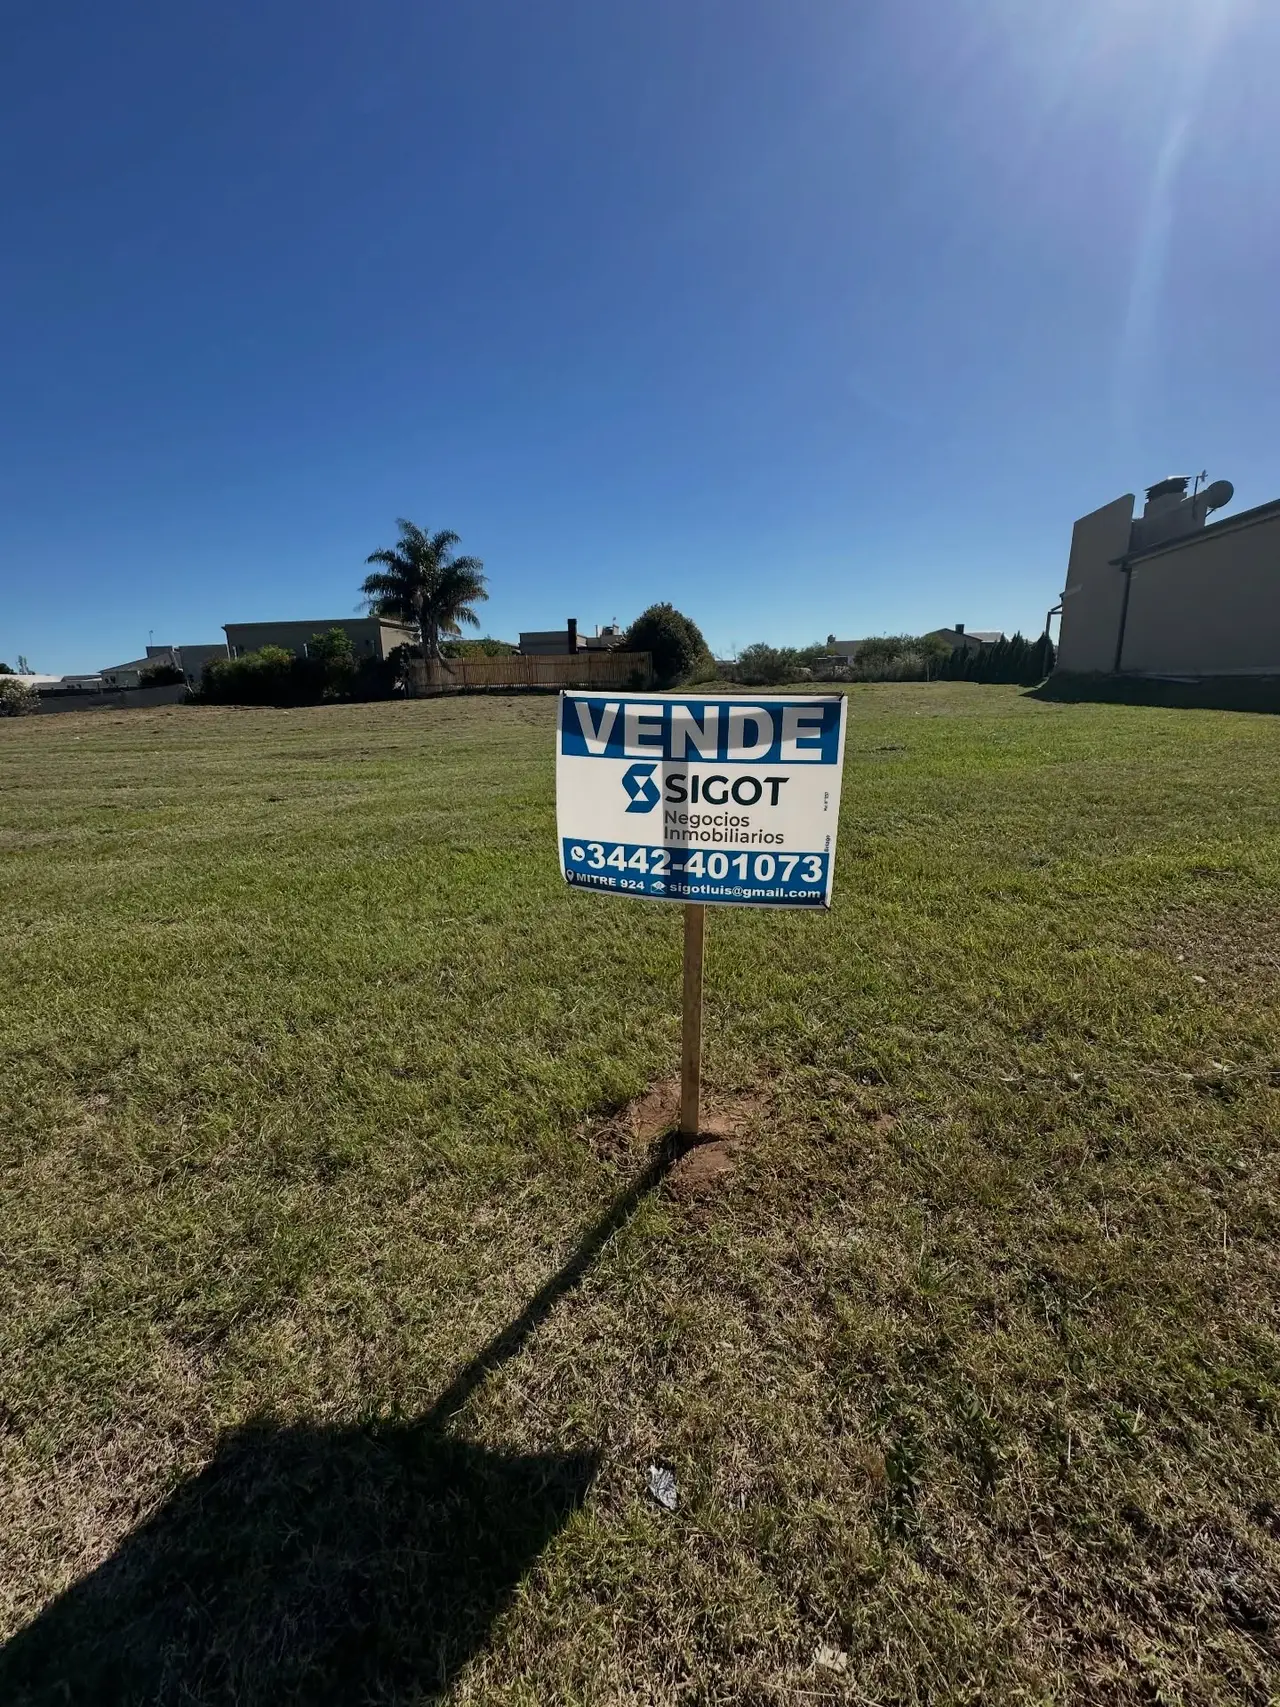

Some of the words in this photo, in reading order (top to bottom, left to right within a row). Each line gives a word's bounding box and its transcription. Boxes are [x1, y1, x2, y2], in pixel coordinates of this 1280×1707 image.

[574, 701, 825, 761] VENDE
[665, 774, 790, 806] SIGOT
[664, 810, 750, 828] Negocios
[664, 826, 784, 844] Inmobiliarios
[587, 843, 823, 882] 3442-401073
[576, 874, 617, 887] MITRE
[620, 878, 645, 890] 924
[669, 882, 821, 899] sigotluis@gmail.com
